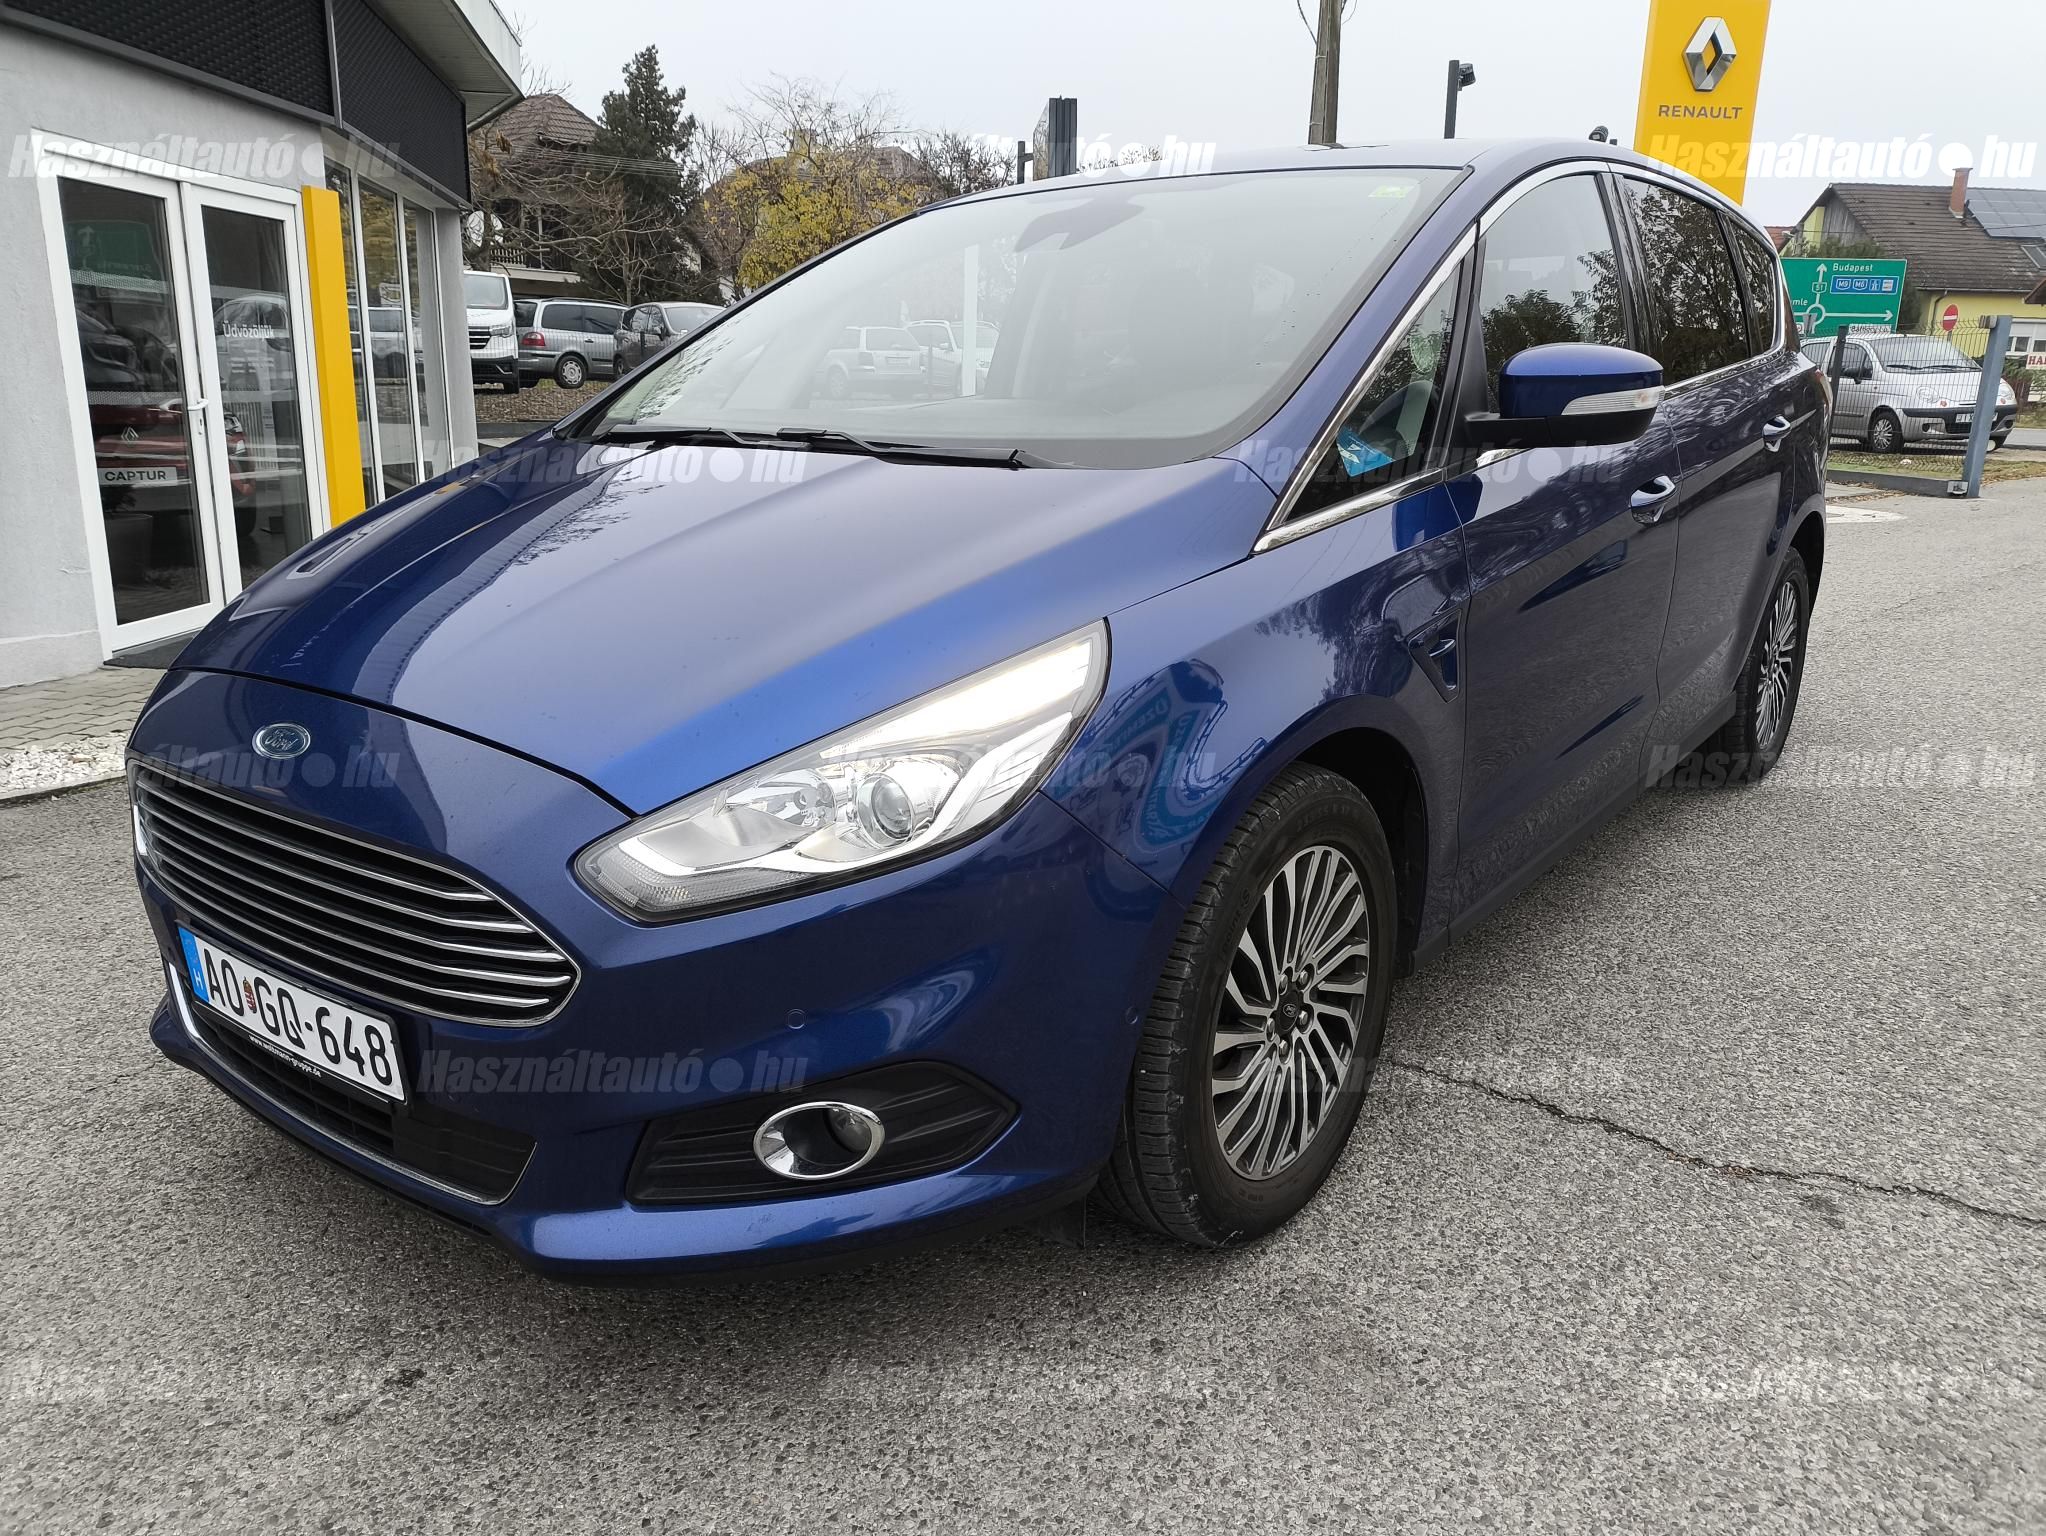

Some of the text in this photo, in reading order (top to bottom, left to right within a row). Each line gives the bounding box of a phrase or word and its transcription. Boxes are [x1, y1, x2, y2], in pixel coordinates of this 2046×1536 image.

[1658, 104, 1743, 119] RENAULT
[1832, 262, 1873, 273] Budapest
[223, 320, 275, 341] Üdvözöljük
[104, 470, 167, 482] CAPTUR
